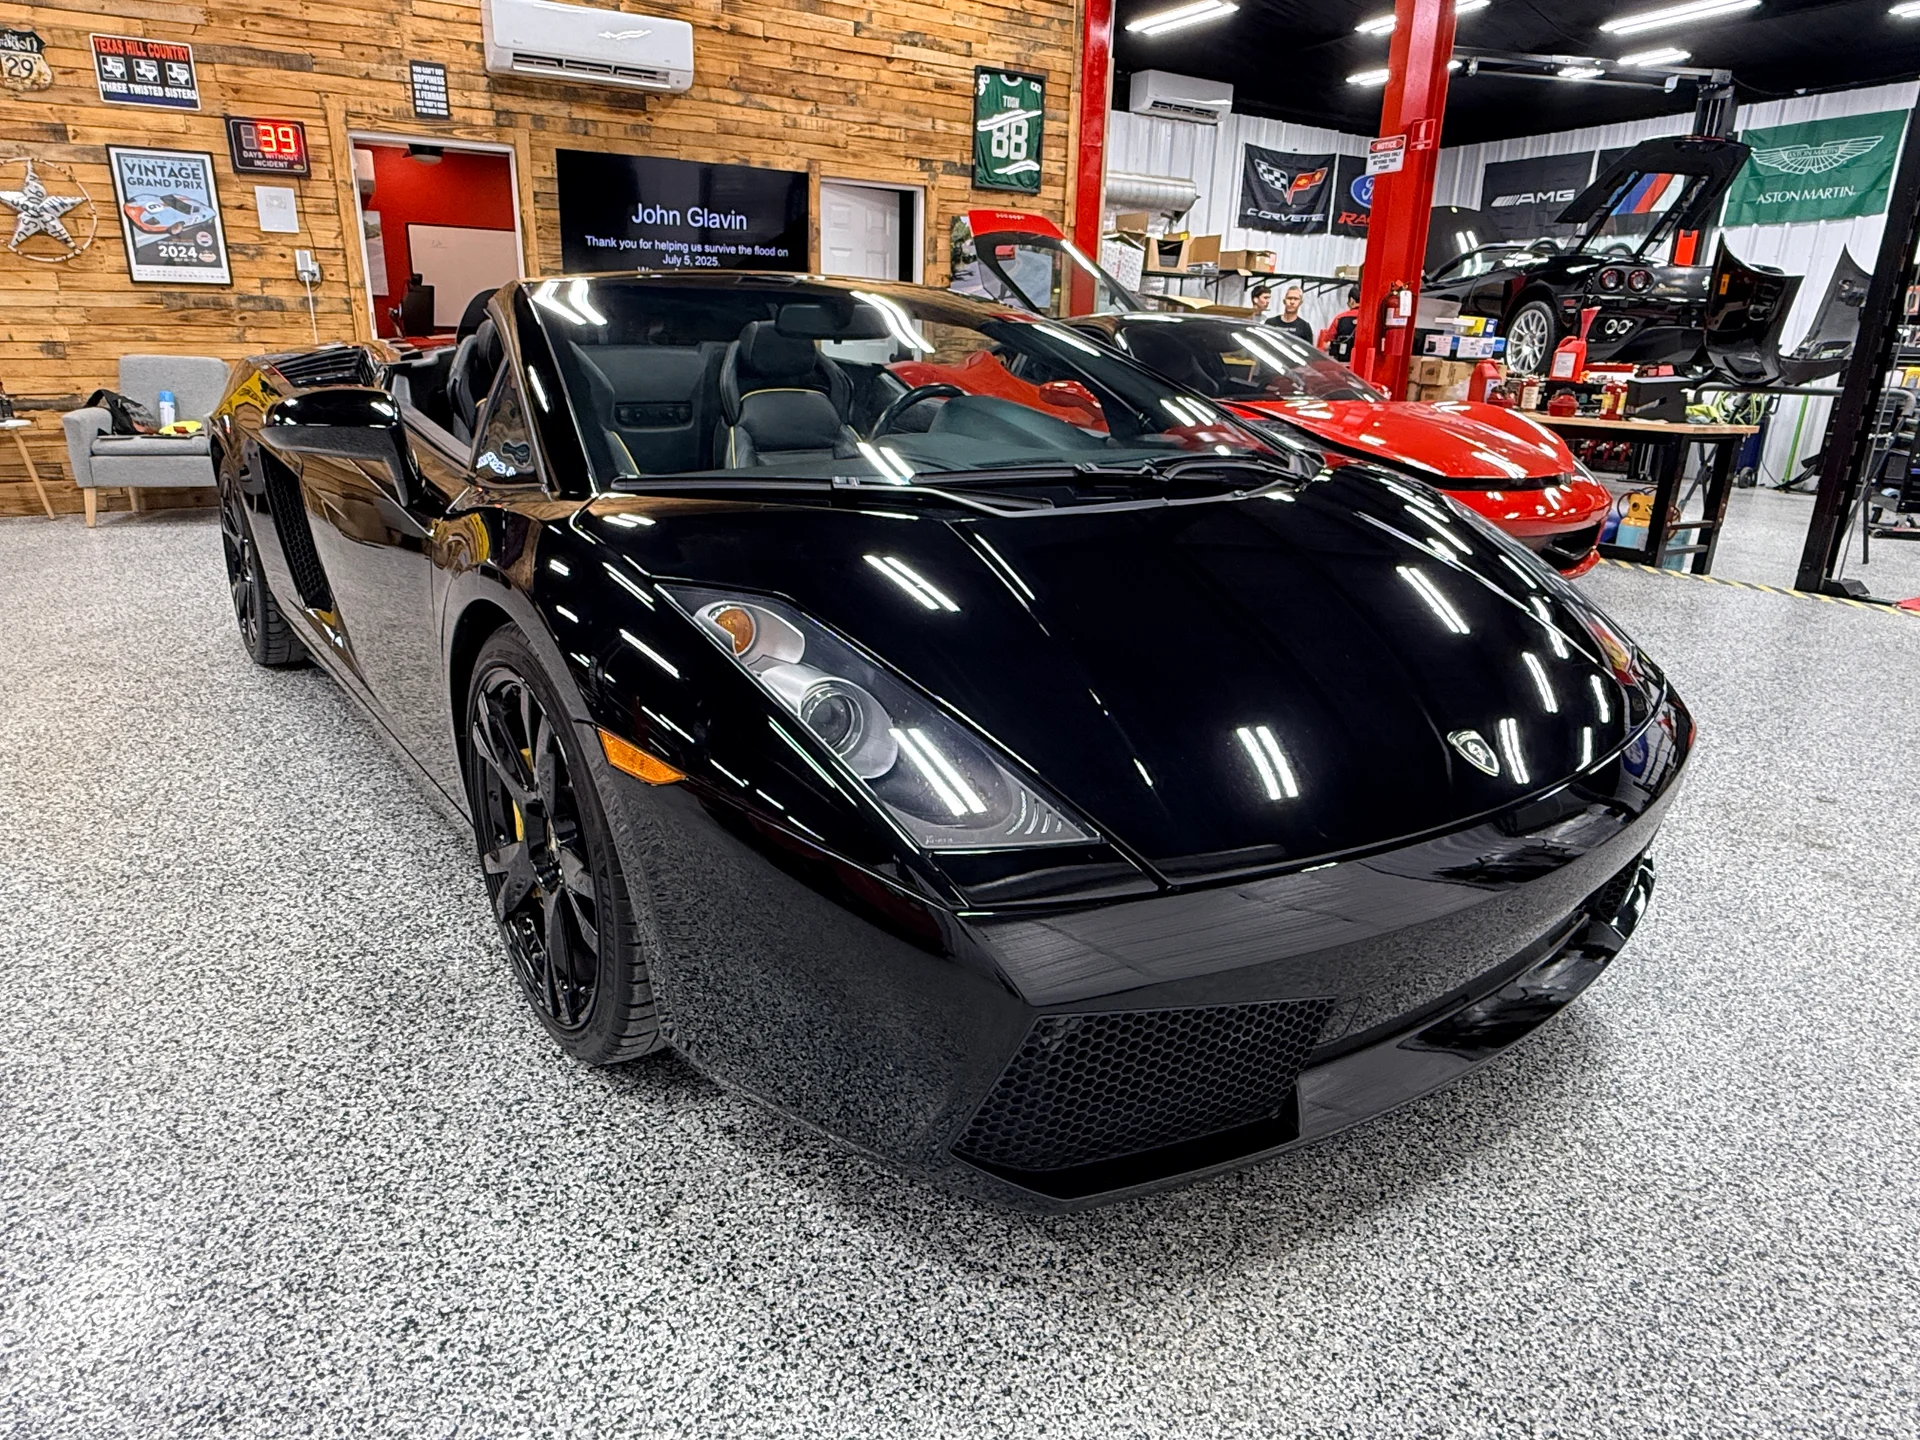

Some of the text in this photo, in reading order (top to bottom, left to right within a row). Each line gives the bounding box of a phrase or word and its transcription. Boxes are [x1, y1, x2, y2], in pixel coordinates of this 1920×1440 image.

[93, 37, 189, 61] TEXAS HILL COUNTRY
[100, 81, 198, 101] THREE TWISTED SISTERS
[257, 125, 296, 153] 39
[991, 114, 1028, 160] 88
[1376, 140, 1397, 150] NOTICE
[243, 150, 299, 161] DAYS WITHOUT
[1788, 148, 1838, 158] ASTON MARTIN
[124, 162, 202, 181] VINTAGE
[254, 160, 288, 168] INCIDENT
[127, 176, 203, 190] GRAND PRIX
[1515, 189, 1576, 206] AMG
[1756, 185, 1856, 205] ASTON MARTIN
[631, 203, 748, 230] John Glavin
[1247, 208, 1325, 222] CORVETTE
[158, 245, 198, 258] 2024
[585, 235, 789, 257] Thank you for helping us survive the flood on
[662, 253, 721, 267] July 5, 2025.
